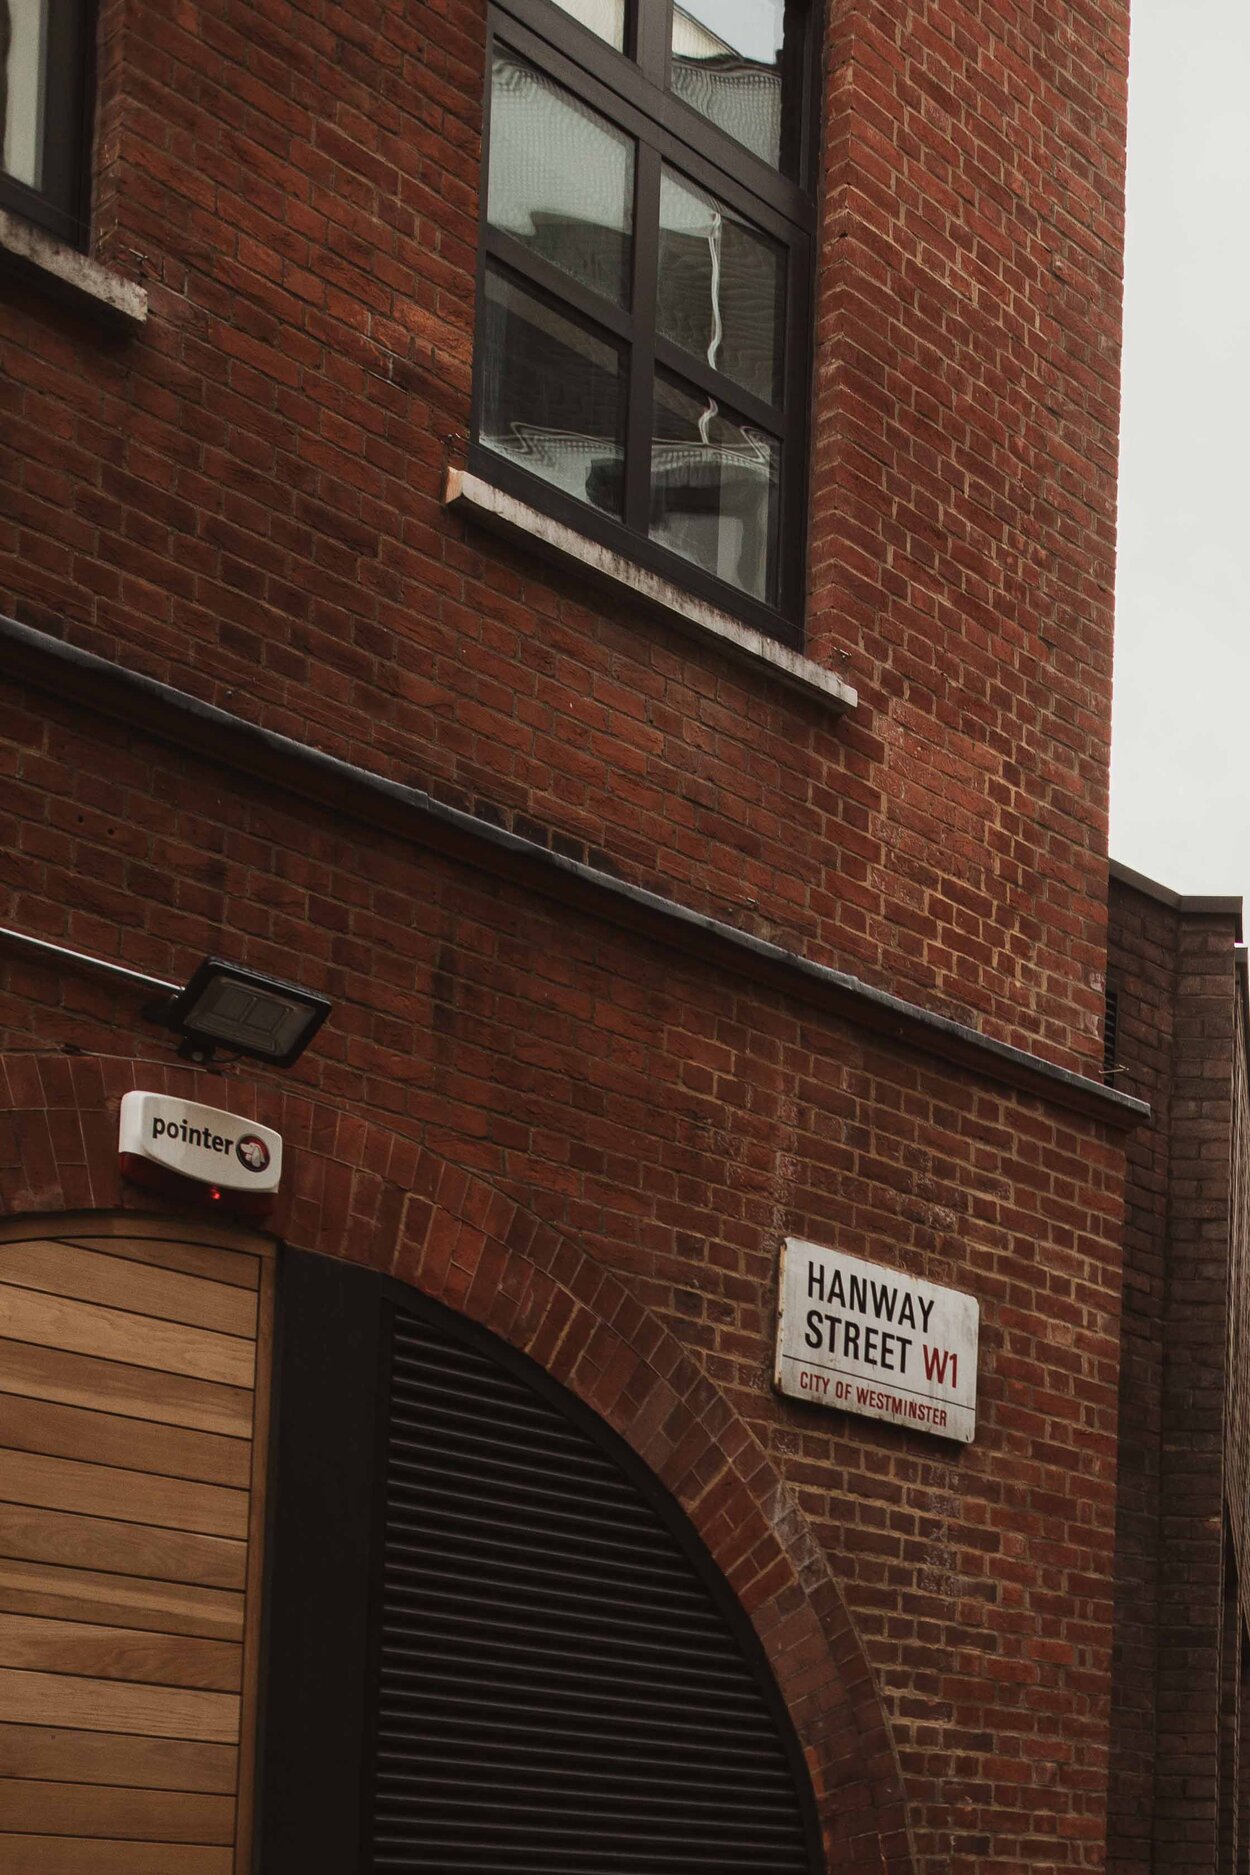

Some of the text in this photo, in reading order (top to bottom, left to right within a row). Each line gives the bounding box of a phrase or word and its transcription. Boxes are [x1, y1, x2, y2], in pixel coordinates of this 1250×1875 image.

[153, 1117, 234, 1154] pointer
[808, 1260, 935, 1333] HANWAY
[804, 1309, 958, 1389] STREET W1
[800, 1371, 947, 1428] CITY OF WESTMINSTER
